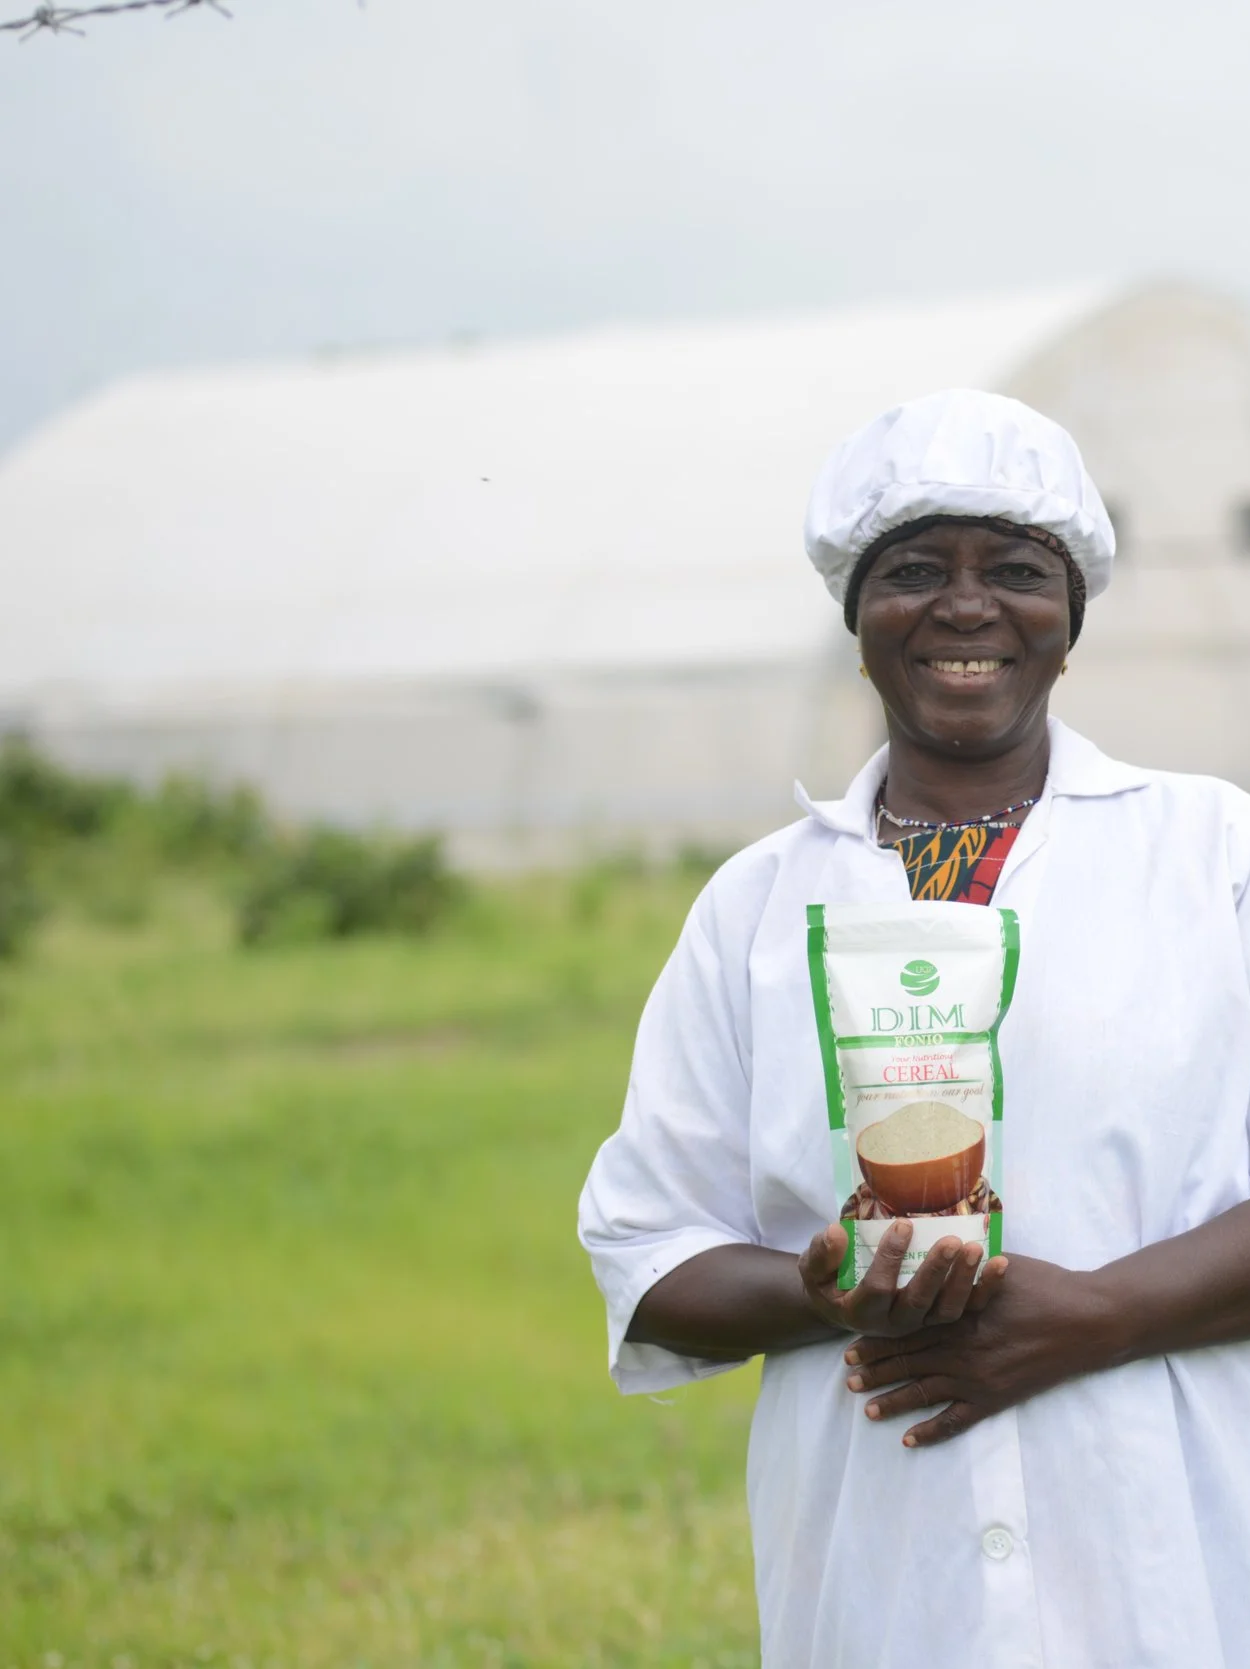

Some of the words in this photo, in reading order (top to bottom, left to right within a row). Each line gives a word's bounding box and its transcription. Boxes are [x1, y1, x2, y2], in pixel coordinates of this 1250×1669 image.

[870, 1004, 966, 1032] DIM
[894, 1033, 944, 1048] FONIO
[883, 1063, 959, 1083] CEREAL
[856, 1091, 879, 1108] your
[942, 1086, 960, 1097] our
